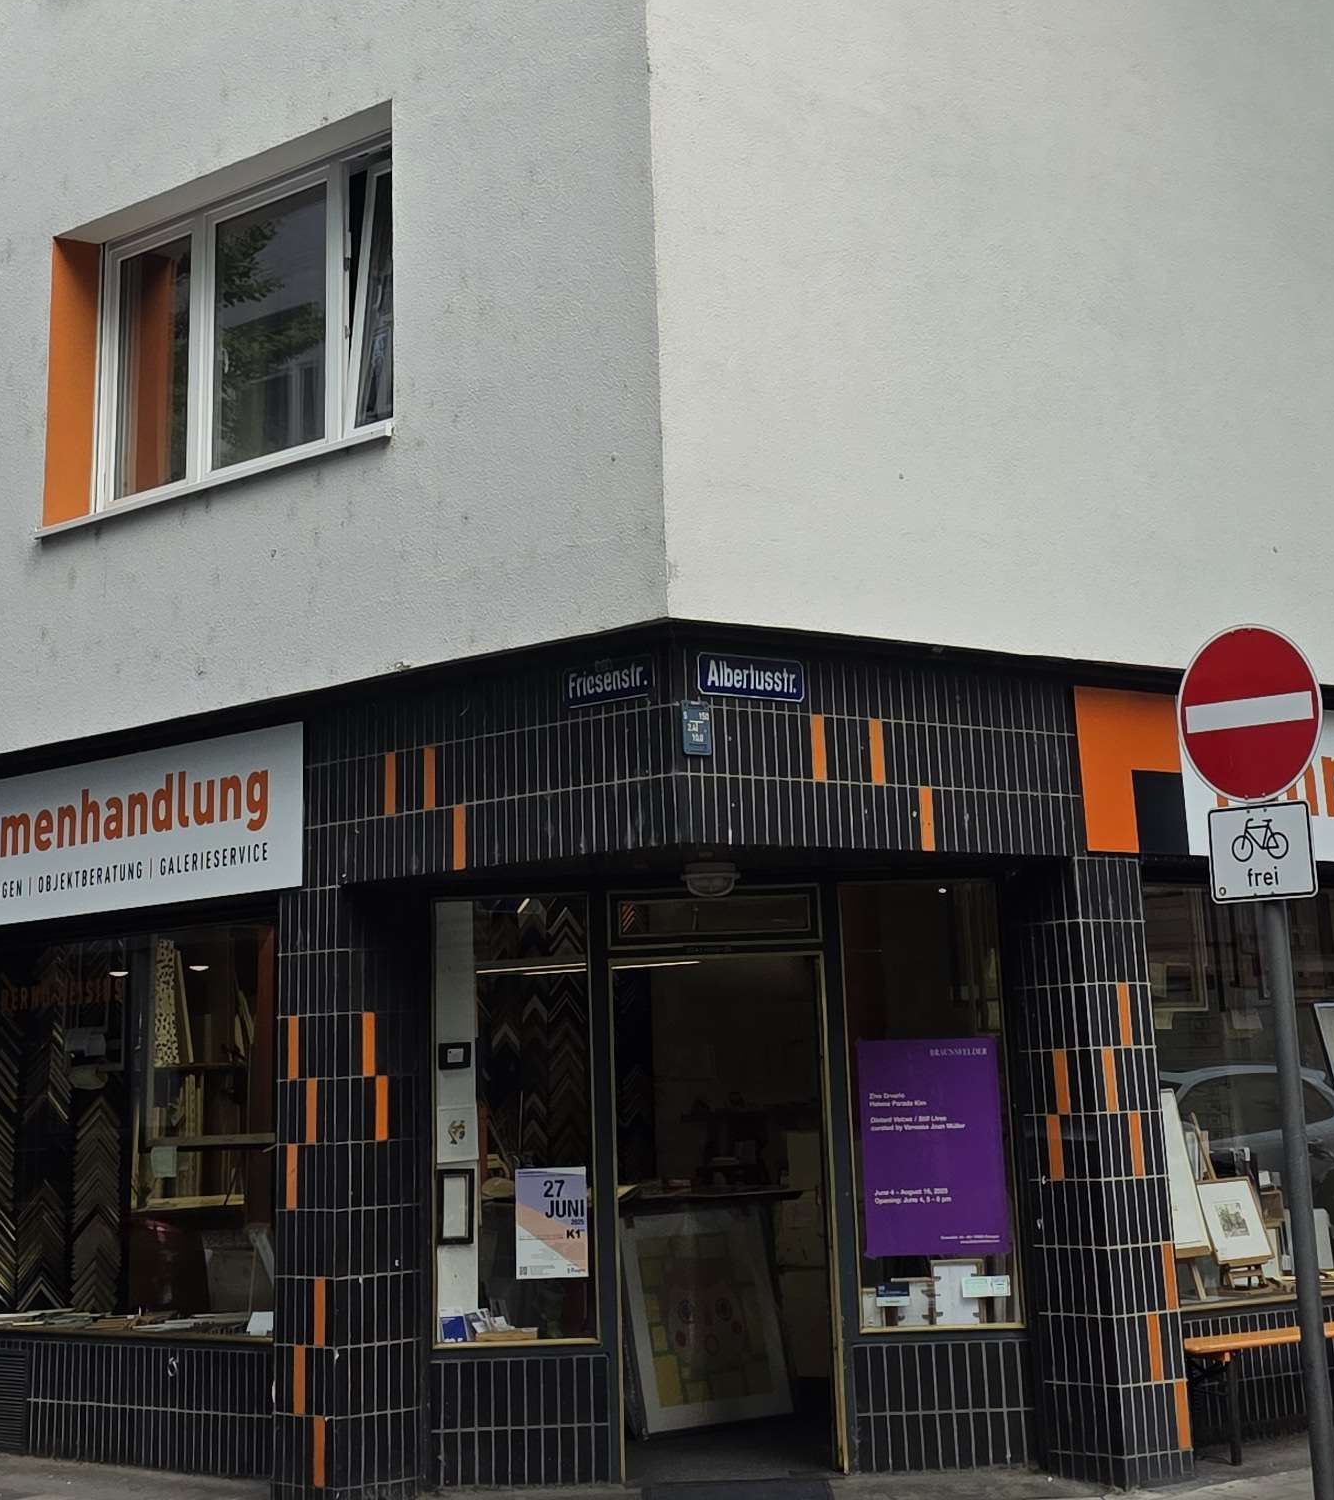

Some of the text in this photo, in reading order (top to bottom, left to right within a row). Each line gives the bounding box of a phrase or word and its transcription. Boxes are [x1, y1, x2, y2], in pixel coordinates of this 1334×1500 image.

[707, 659, 797, 694] Albertusstr.
[38, 861, 143, 893] OBJEKTBERATUNG
[159, 842, 269, 876] GALERIESERVICE
[1247, 866, 1280, 887] frei
[543, 1179, 565, 1198] 27
[545, 1199, 584, 1219] JUNI
